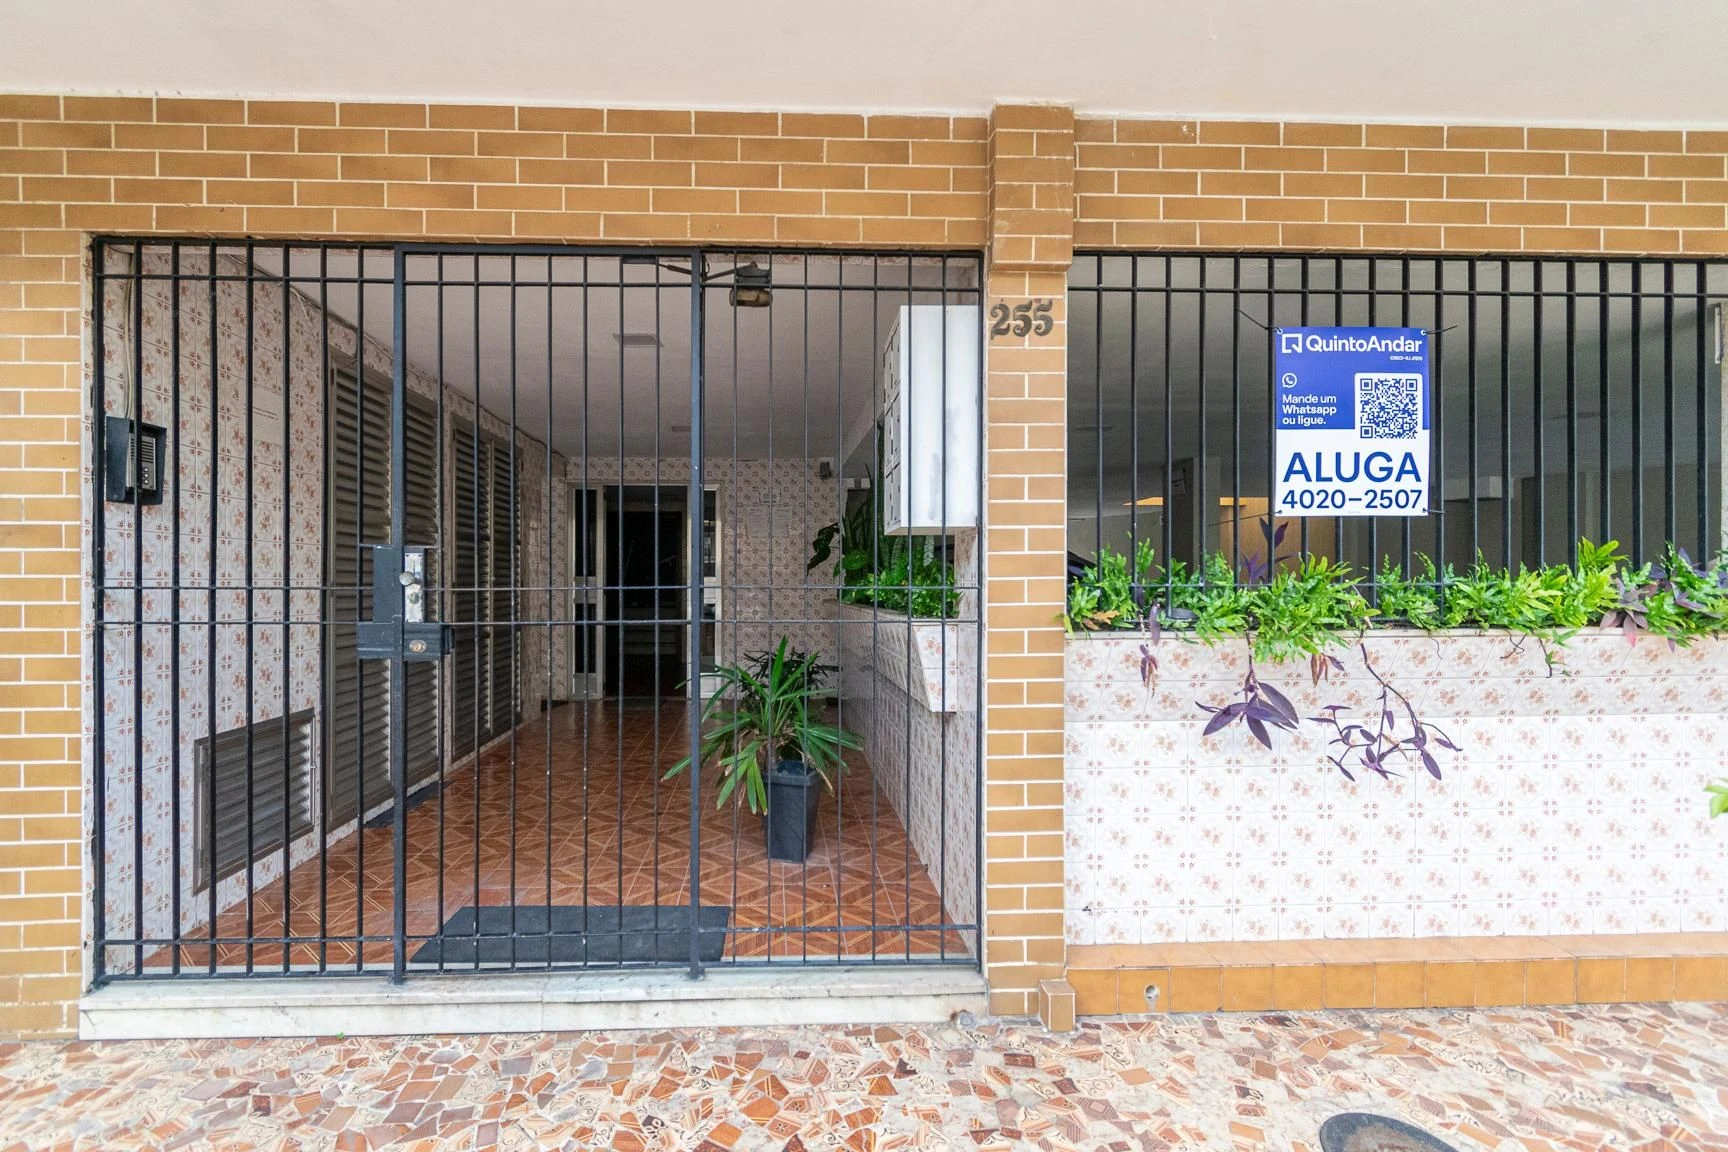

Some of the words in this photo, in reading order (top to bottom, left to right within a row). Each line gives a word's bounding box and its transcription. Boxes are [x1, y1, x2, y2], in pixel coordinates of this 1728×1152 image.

[991, 298, 1053, 340] 255
[1306, 334, 1422, 352] QuintoAndar
[1282, 394, 1318, 404] Mande
[1320, 396, 1337, 404] um
[1282, 405, 1337, 416] Whatsapp
[1282, 417, 1296, 425] ou
[1298, 415, 1327, 427] ligue.
[1283, 451, 1422, 483] ALUGA
[1282, 489, 1423, 509] 4020-2507
